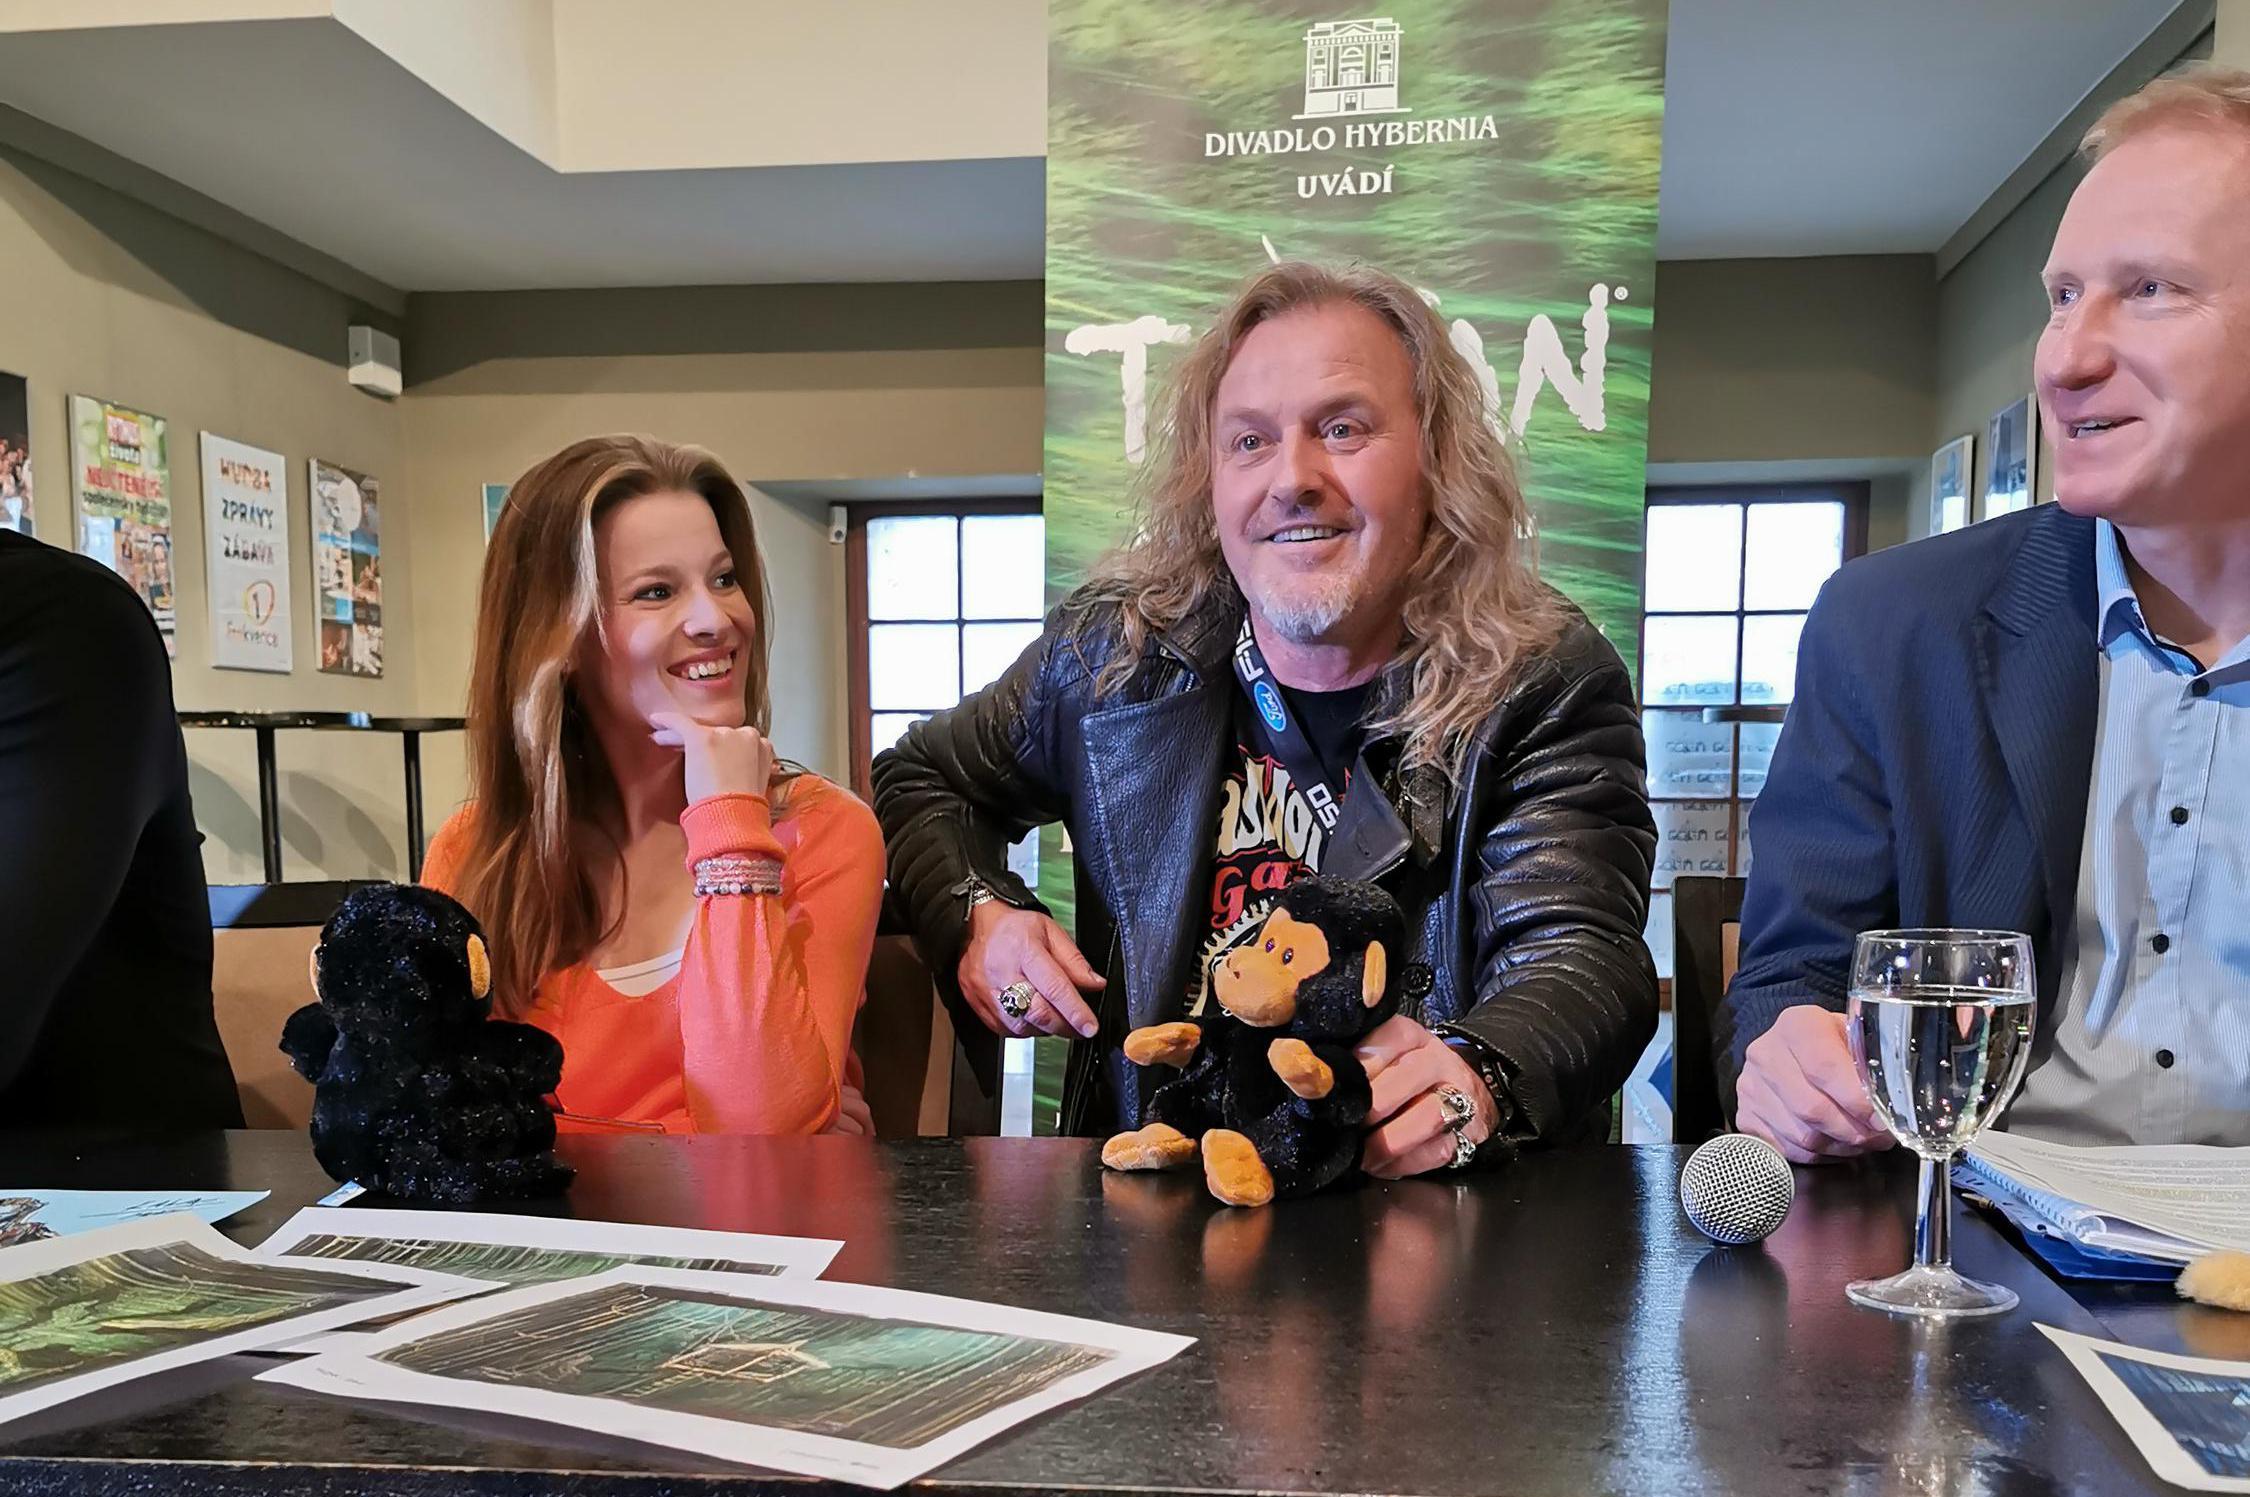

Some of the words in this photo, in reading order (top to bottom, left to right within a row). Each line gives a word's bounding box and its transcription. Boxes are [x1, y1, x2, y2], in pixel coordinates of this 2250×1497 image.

[1204, 126, 1337, 157] DIVADLO
[1345, 115, 1499, 149] HYBERNIA
[1297, 164, 1395, 199] UVÁDÍ
[1306, 782, 1341, 836] 50
[1211, 861, 1303, 929] Ga
